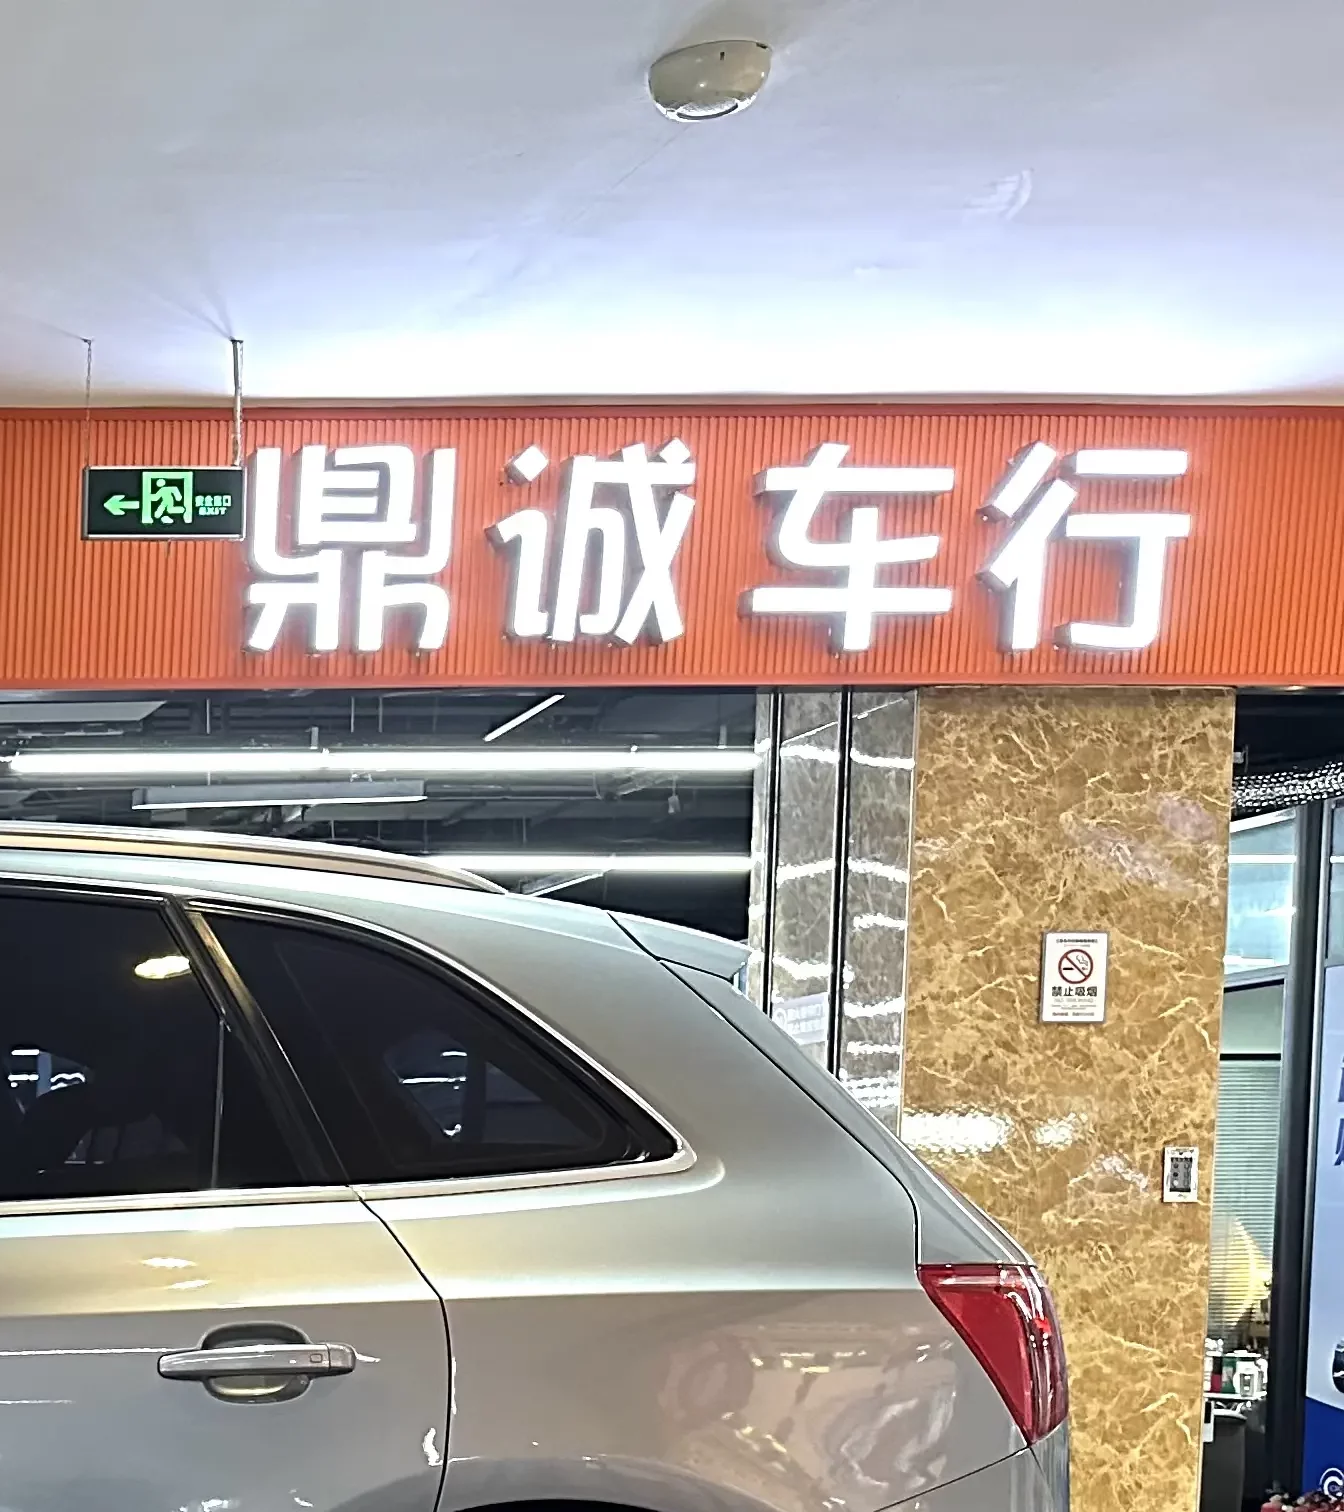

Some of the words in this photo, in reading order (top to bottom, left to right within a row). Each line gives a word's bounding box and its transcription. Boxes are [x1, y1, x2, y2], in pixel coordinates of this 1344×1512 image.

[246, 437, 1191, 653] 鼎诚车行
[1052, 985, 1098, 997] 禁止吸烟
